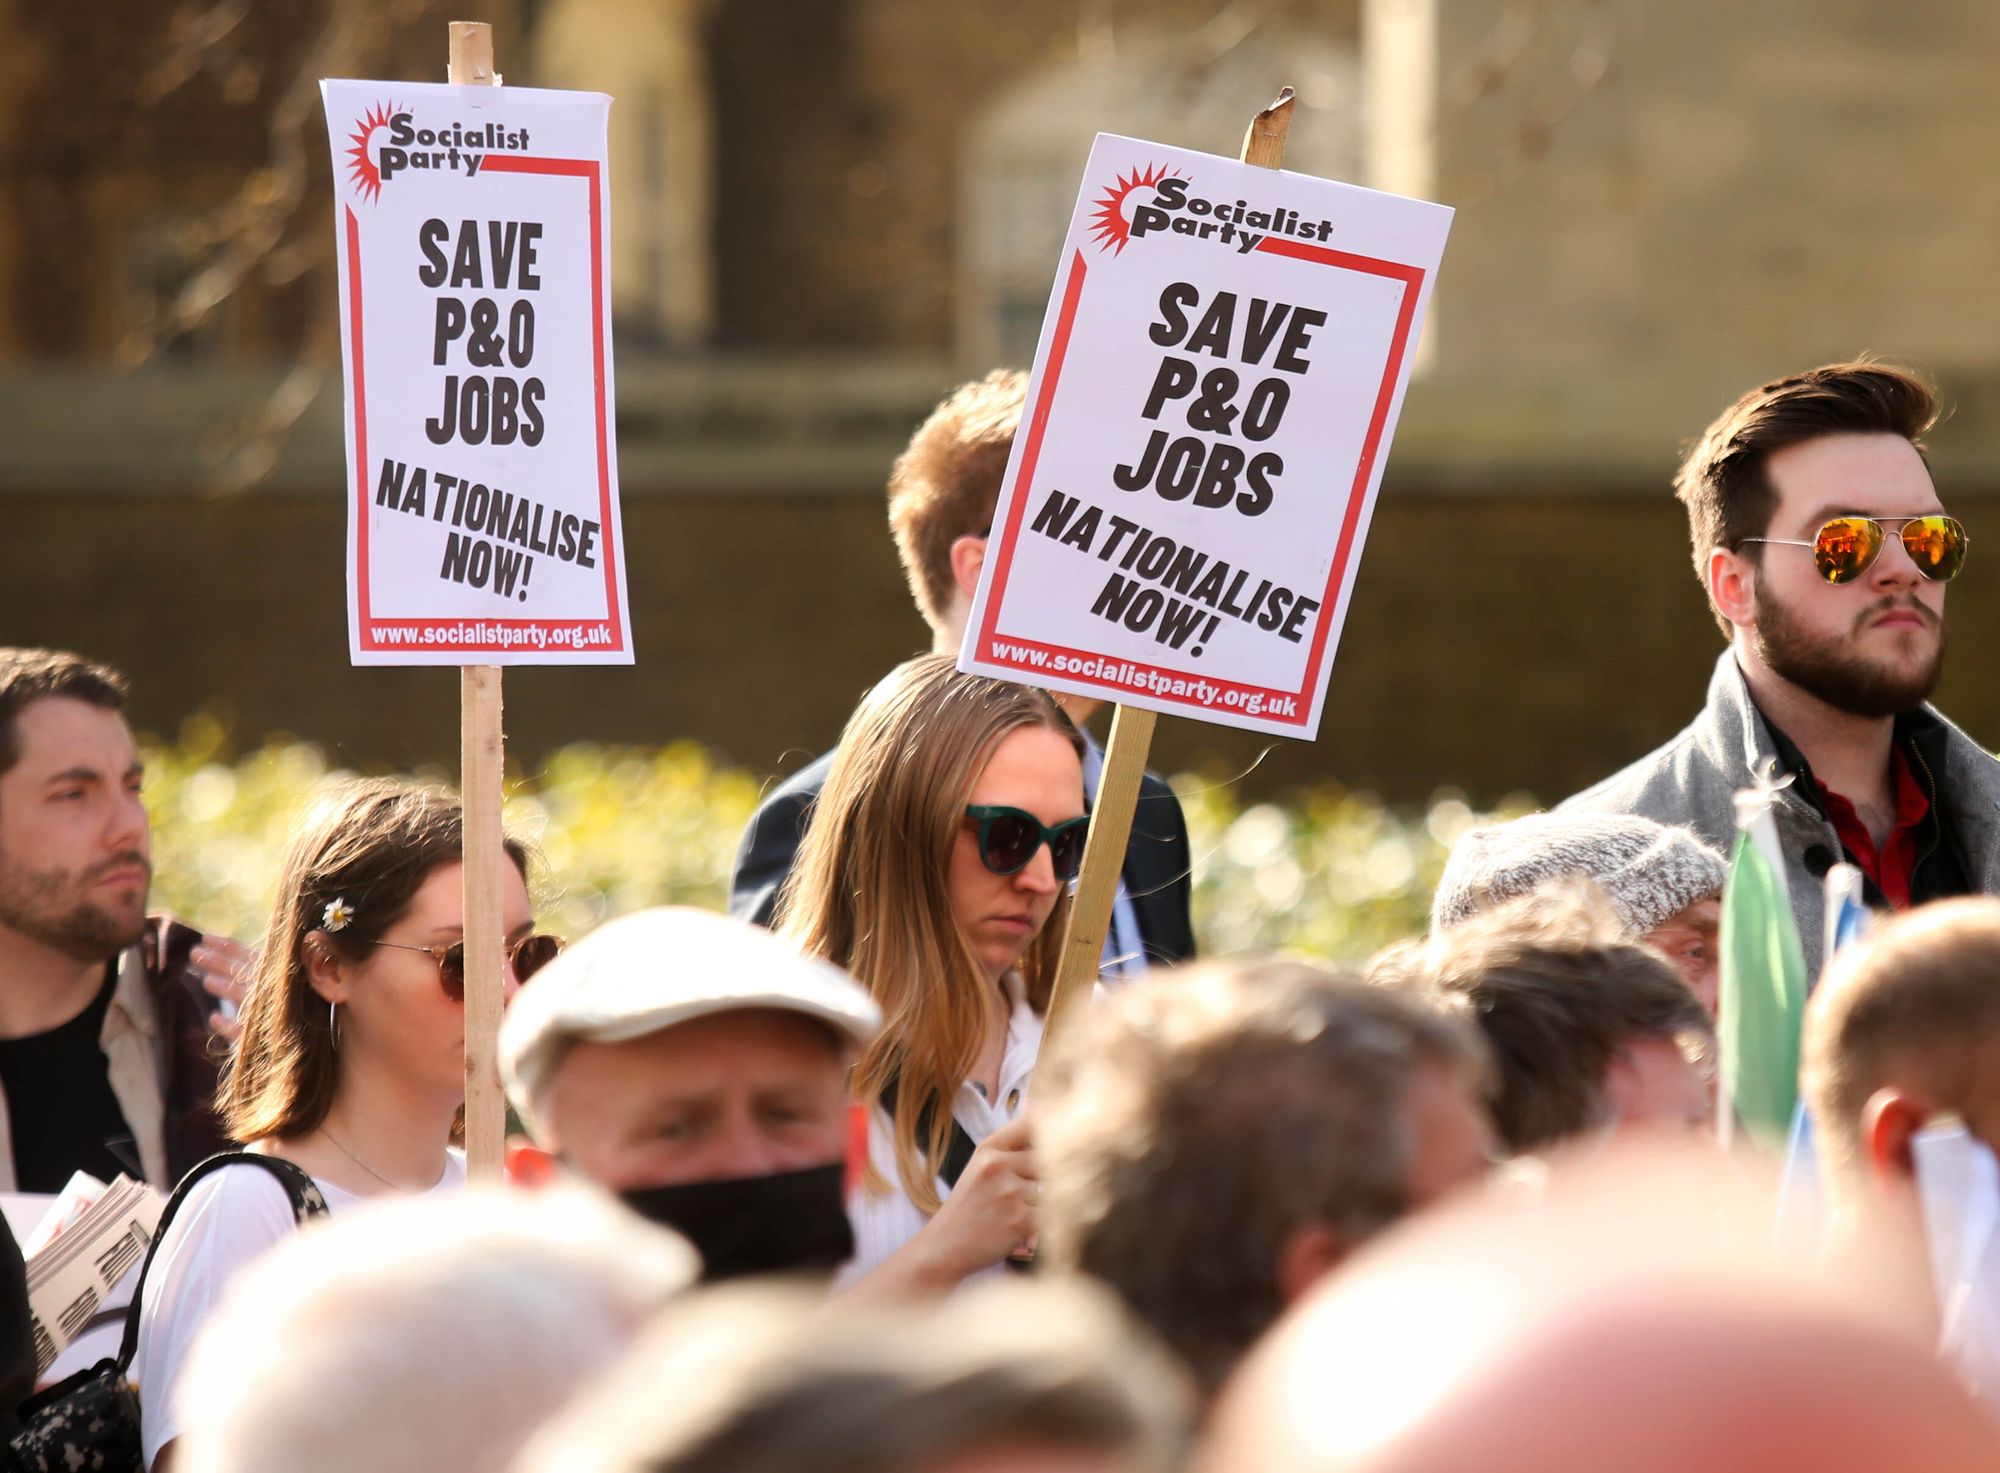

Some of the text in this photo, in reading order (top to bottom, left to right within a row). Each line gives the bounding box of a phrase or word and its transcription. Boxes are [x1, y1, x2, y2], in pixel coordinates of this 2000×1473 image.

[379, 147, 482, 180] Party
[389, 112, 530, 150] Socialist
[1129, 204, 1263, 254] Party
[1151, 178, 1333, 242] Socialist
[419, 218, 543, 291] SAVE
[433, 297, 535, 368] P&O
[1148, 281, 1328, 375] SAVE
[425, 375, 546, 447] JOBS
[1141, 355, 1290, 442] P&O
[1113, 429, 1284, 517] JOBS
[376, 457, 600, 569] NATIONALISE
[440, 532, 534, 602] NOW!
[1030, 489, 1321, 644] NATIONALISE
[371, 623, 612, 649] www.socialistparty.org.uk
[1090, 573, 1222, 658] NOW!
[991, 641, 1298, 718] www.socialistparty.org.uk
